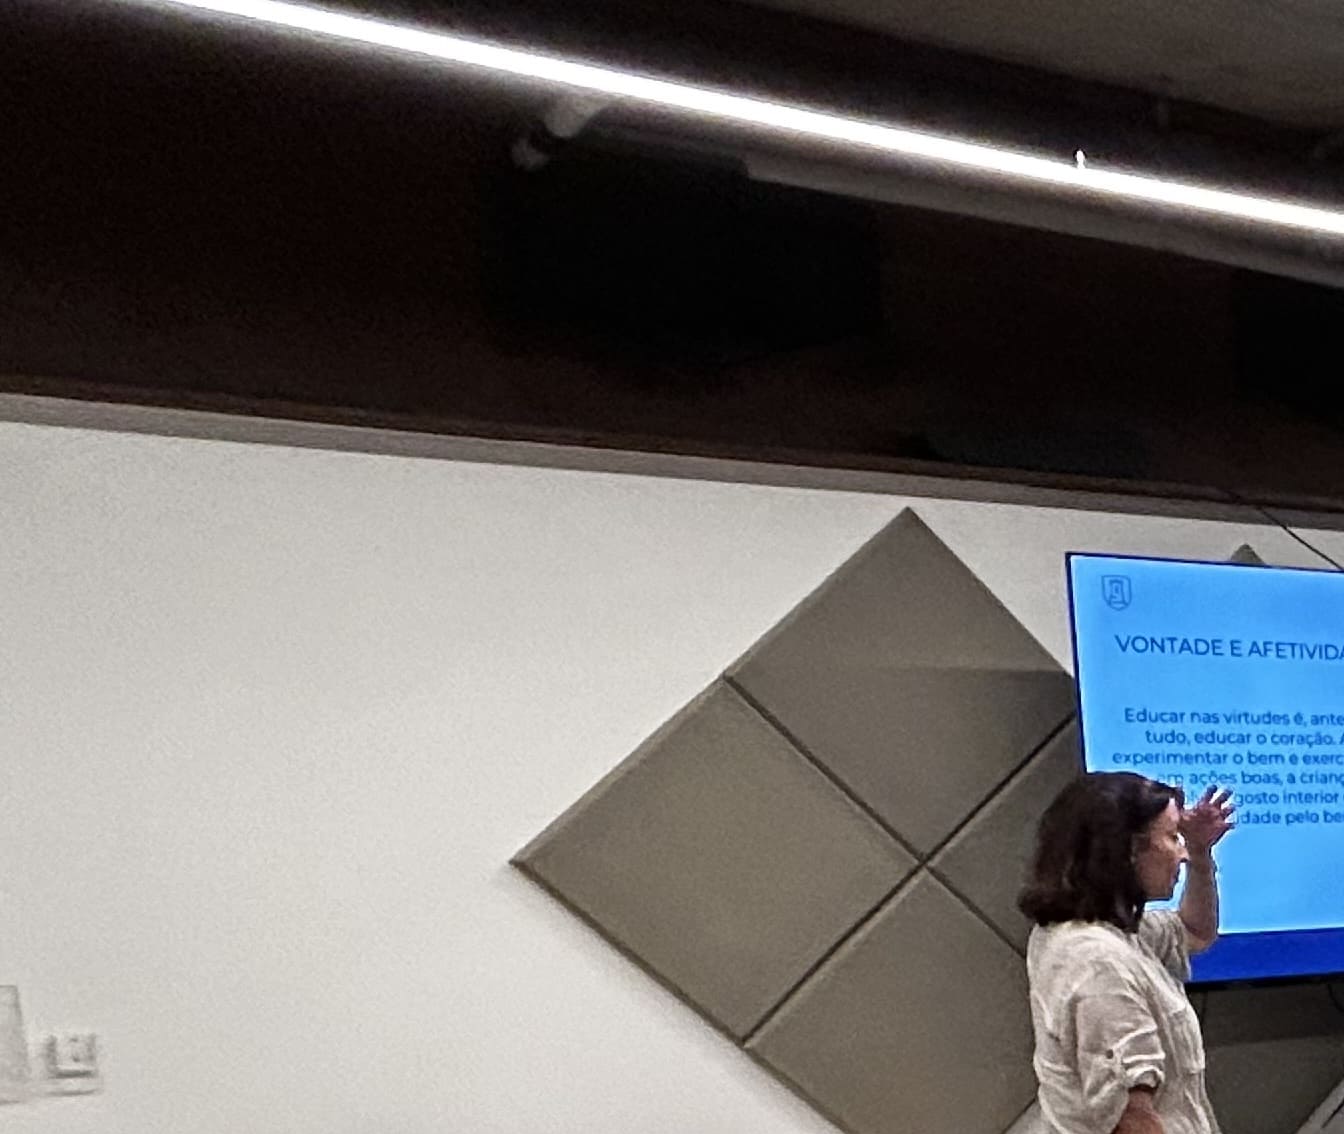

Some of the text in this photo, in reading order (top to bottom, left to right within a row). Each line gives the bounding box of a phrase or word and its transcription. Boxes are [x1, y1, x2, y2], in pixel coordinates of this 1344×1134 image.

[1114, 634, 1225, 656] VONTADE
[1124, 707, 1186, 723] Educar
[1190, 712, 1220, 724] nas
[1223, 710, 1290, 725] virtudes
[1293, 712, 1308, 727] é,
[1145, 730, 1191, 746] tudo,
[1193, 731, 1252, 744] educar
[1270, 732, 1337, 748] coração.
[1112, 750, 1229, 766] experimentar
[1247, 751, 1286, 765] bem
[1189, 770, 1238, 786] ações
[1241, 771, 1284, 786] boas,
[1233, 792, 1280, 807] gosto
[1282, 789, 1339, 804] interior
[1285, 810, 1320, 825] pelo
